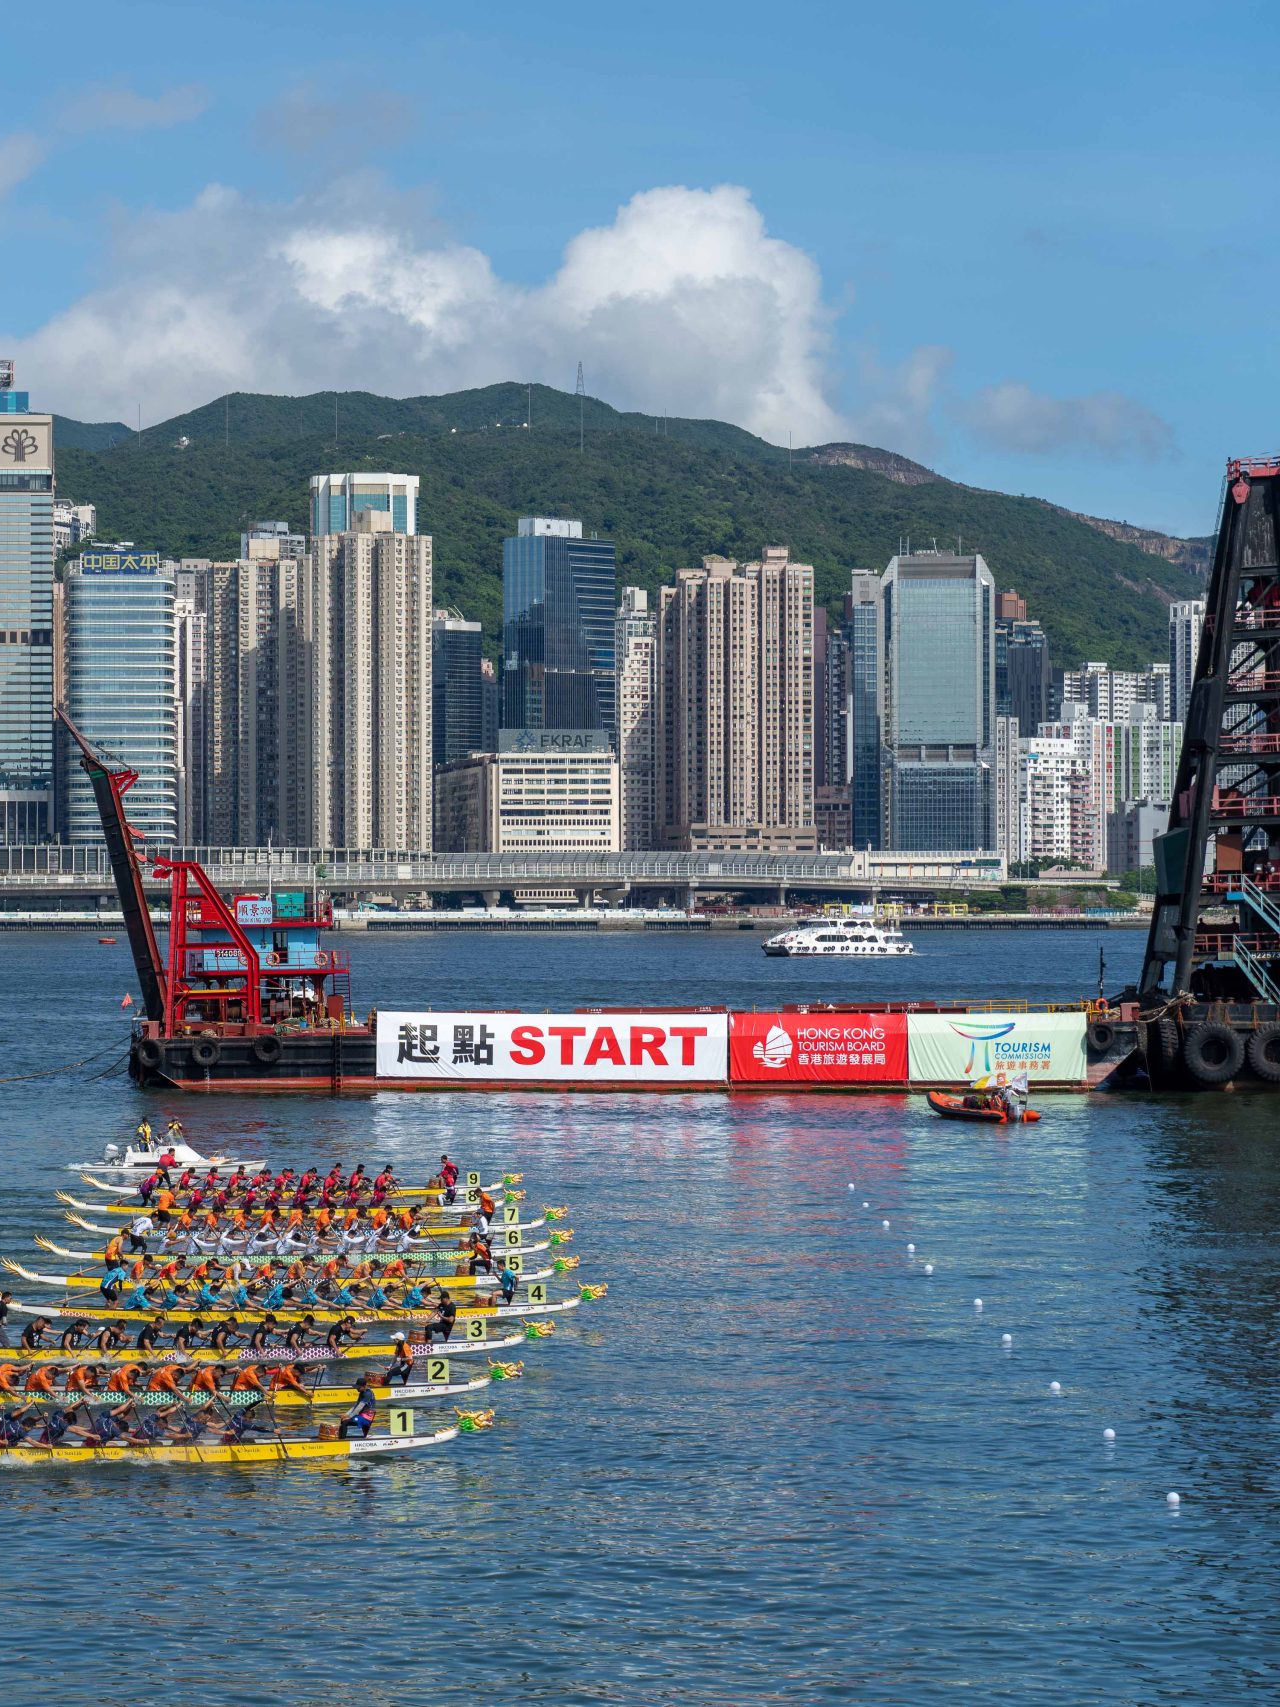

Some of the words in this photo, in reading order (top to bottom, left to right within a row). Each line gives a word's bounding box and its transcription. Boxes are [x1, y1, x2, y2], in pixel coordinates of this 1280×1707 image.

[84, 554, 158, 570] 中国太平
[540, 735, 593, 747] EKRAF
[797, 1028, 840, 1040] HONG
[843, 1028, 885, 1040] KONG
[397, 1024, 495, 1066] 起點
[509, 1026, 707, 1066] START
[797, 1041, 845, 1051] TOURISM
[847, 1041, 885, 1051] BOARD
[995, 1043, 1050, 1052] TOURISM
[798, 1054, 885, 1065] 香港旅遊發展局
[995, 1061, 1050, 1070] 旅遊事務署
[470, 1173, 477, 1184] 9
[468, 1190, 477, 1201] 8
[507, 1208, 516, 1221] 7
[509, 1231, 518, 1244] 6
[510, 1256, 519, 1270] 5
[531, 1286, 543, 1300] 4
[471, 1320, 483, 1337] 3
[431, 1361, 445, 1380] 2
[397, 1412, 407, 1432] 1
